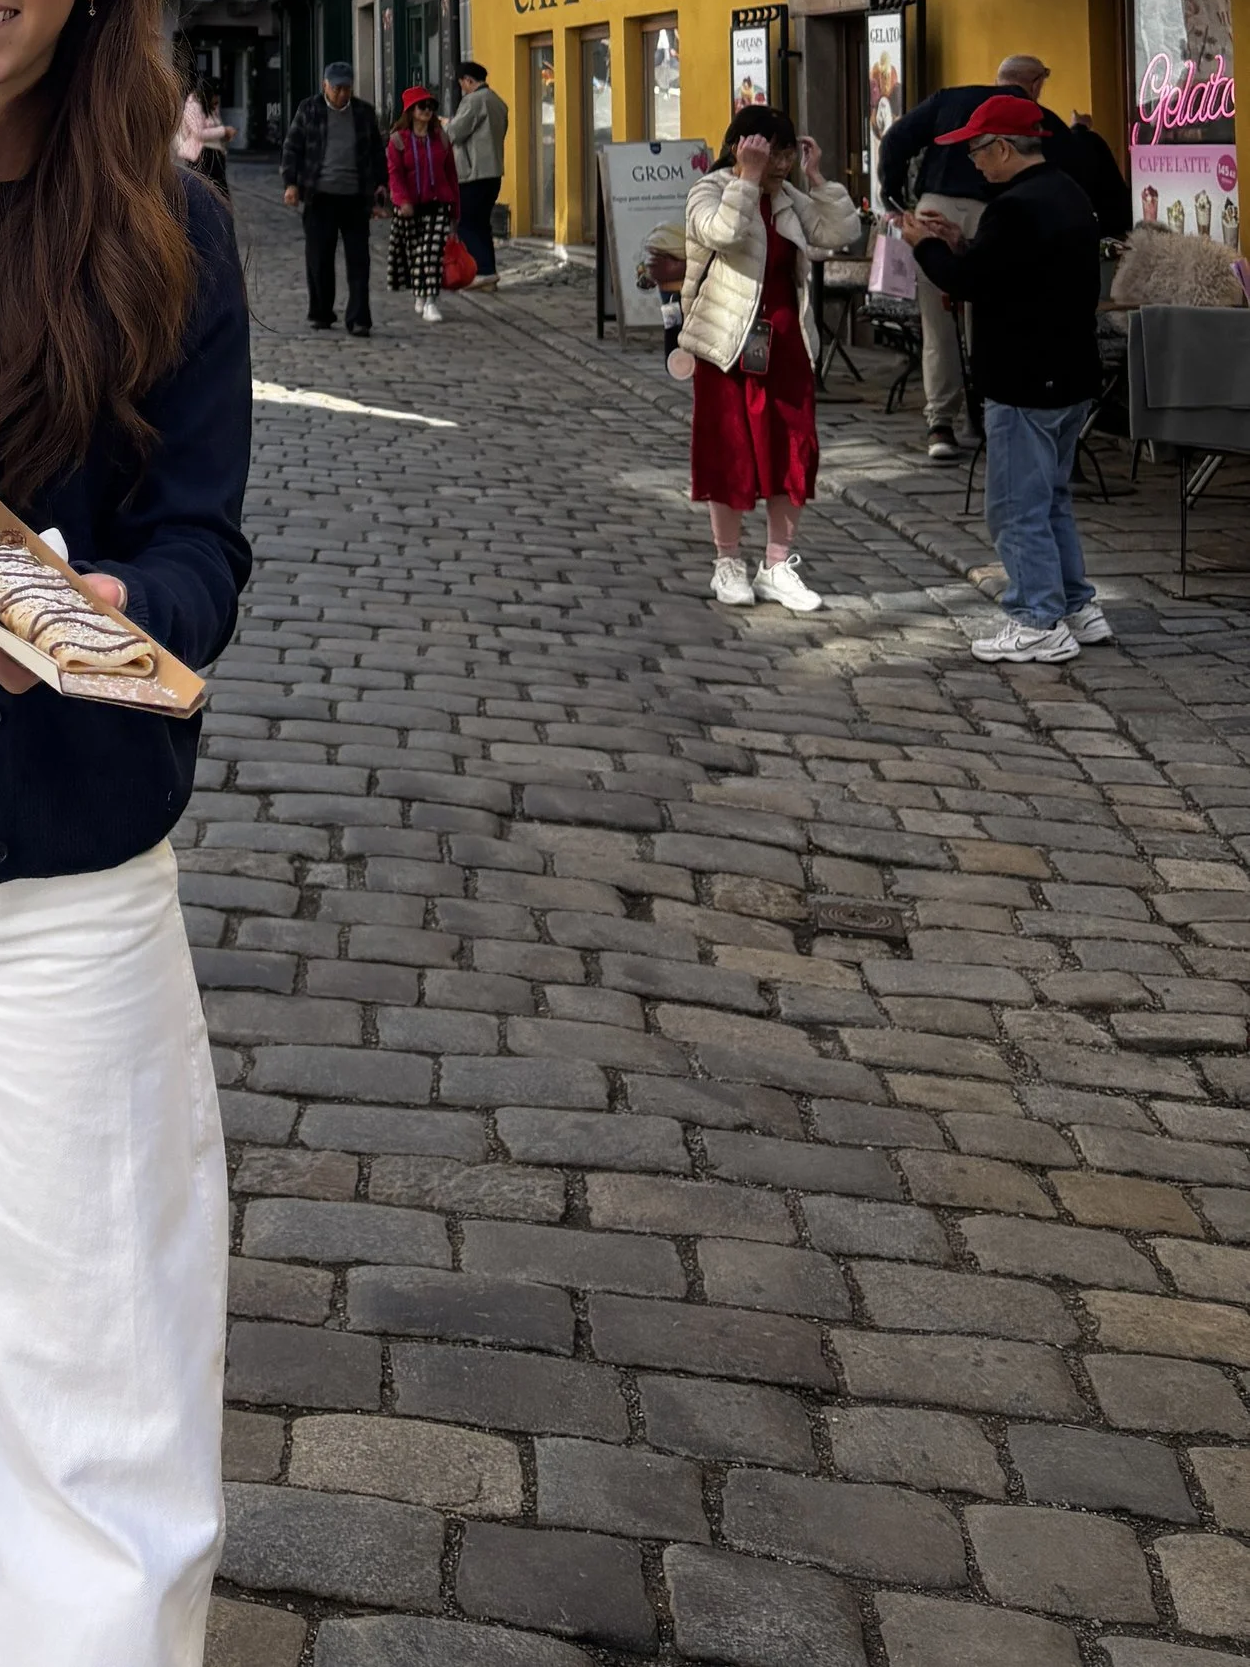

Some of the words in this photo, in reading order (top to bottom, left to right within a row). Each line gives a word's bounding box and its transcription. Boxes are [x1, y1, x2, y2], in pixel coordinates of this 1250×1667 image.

[869, 27, 900, 44] GELATO
[632, 165, 685, 182] GROM
[1138, 155, 1174, 174] CAFFE
[1175, 155, 1212, 175] LATTE
